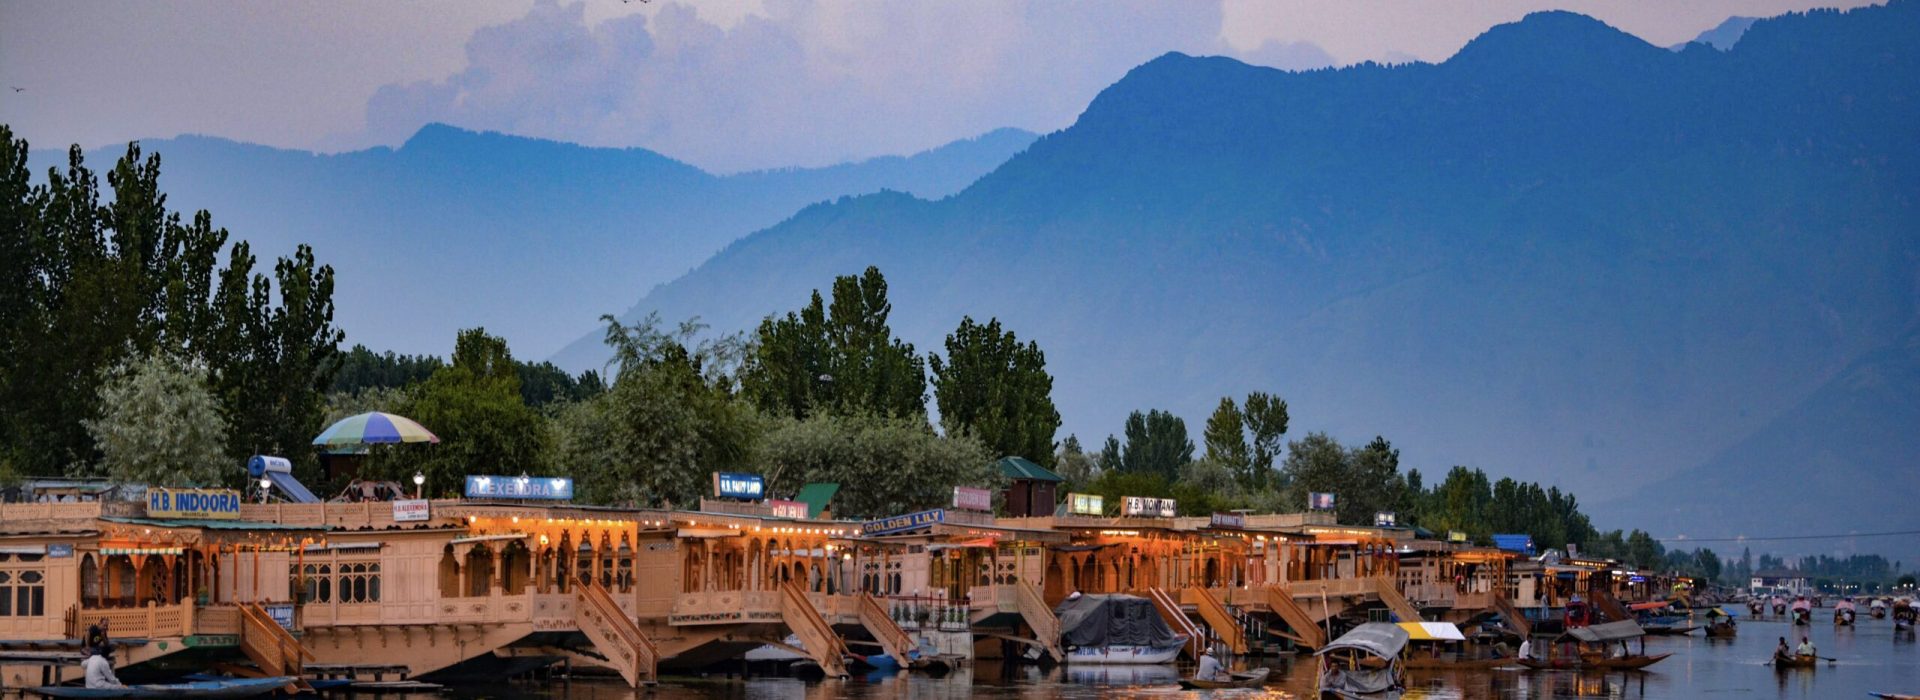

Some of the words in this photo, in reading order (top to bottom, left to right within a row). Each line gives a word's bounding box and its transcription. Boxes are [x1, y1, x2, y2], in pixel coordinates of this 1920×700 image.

[469, 482, 549, 496] ALEXENDRA
[151, 492, 172, 511] H.B.
[175, 493, 239, 512] INDOORA
[1127, 498, 1141, 510] H.B.
[1143, 499, 1176, 512] MONTANA
[865, 518, 912, 533] GOLDEN
[915, 511, 939, 525] LILY
